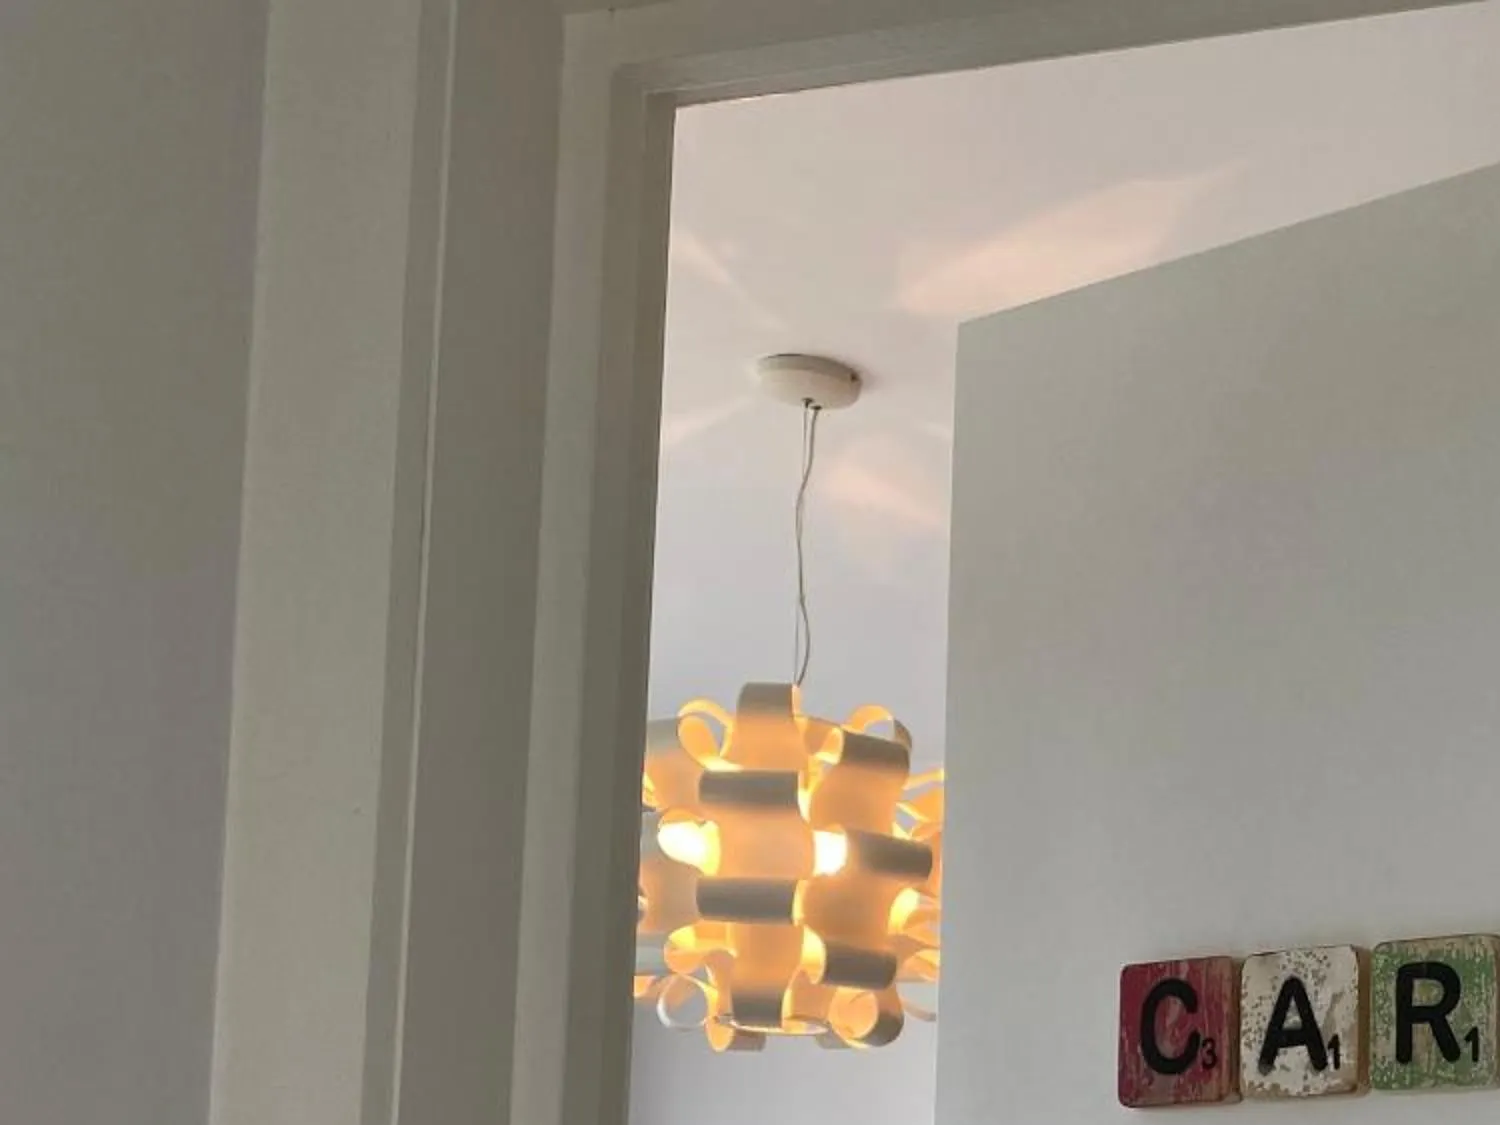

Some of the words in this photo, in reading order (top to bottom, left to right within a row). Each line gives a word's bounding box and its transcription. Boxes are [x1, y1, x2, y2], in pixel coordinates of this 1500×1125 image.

[1201, 1037, 1218, 1069] 3
[1326, 1034, 1341, 1071] 1
[1463, 1026, 1479, 1062] 1
